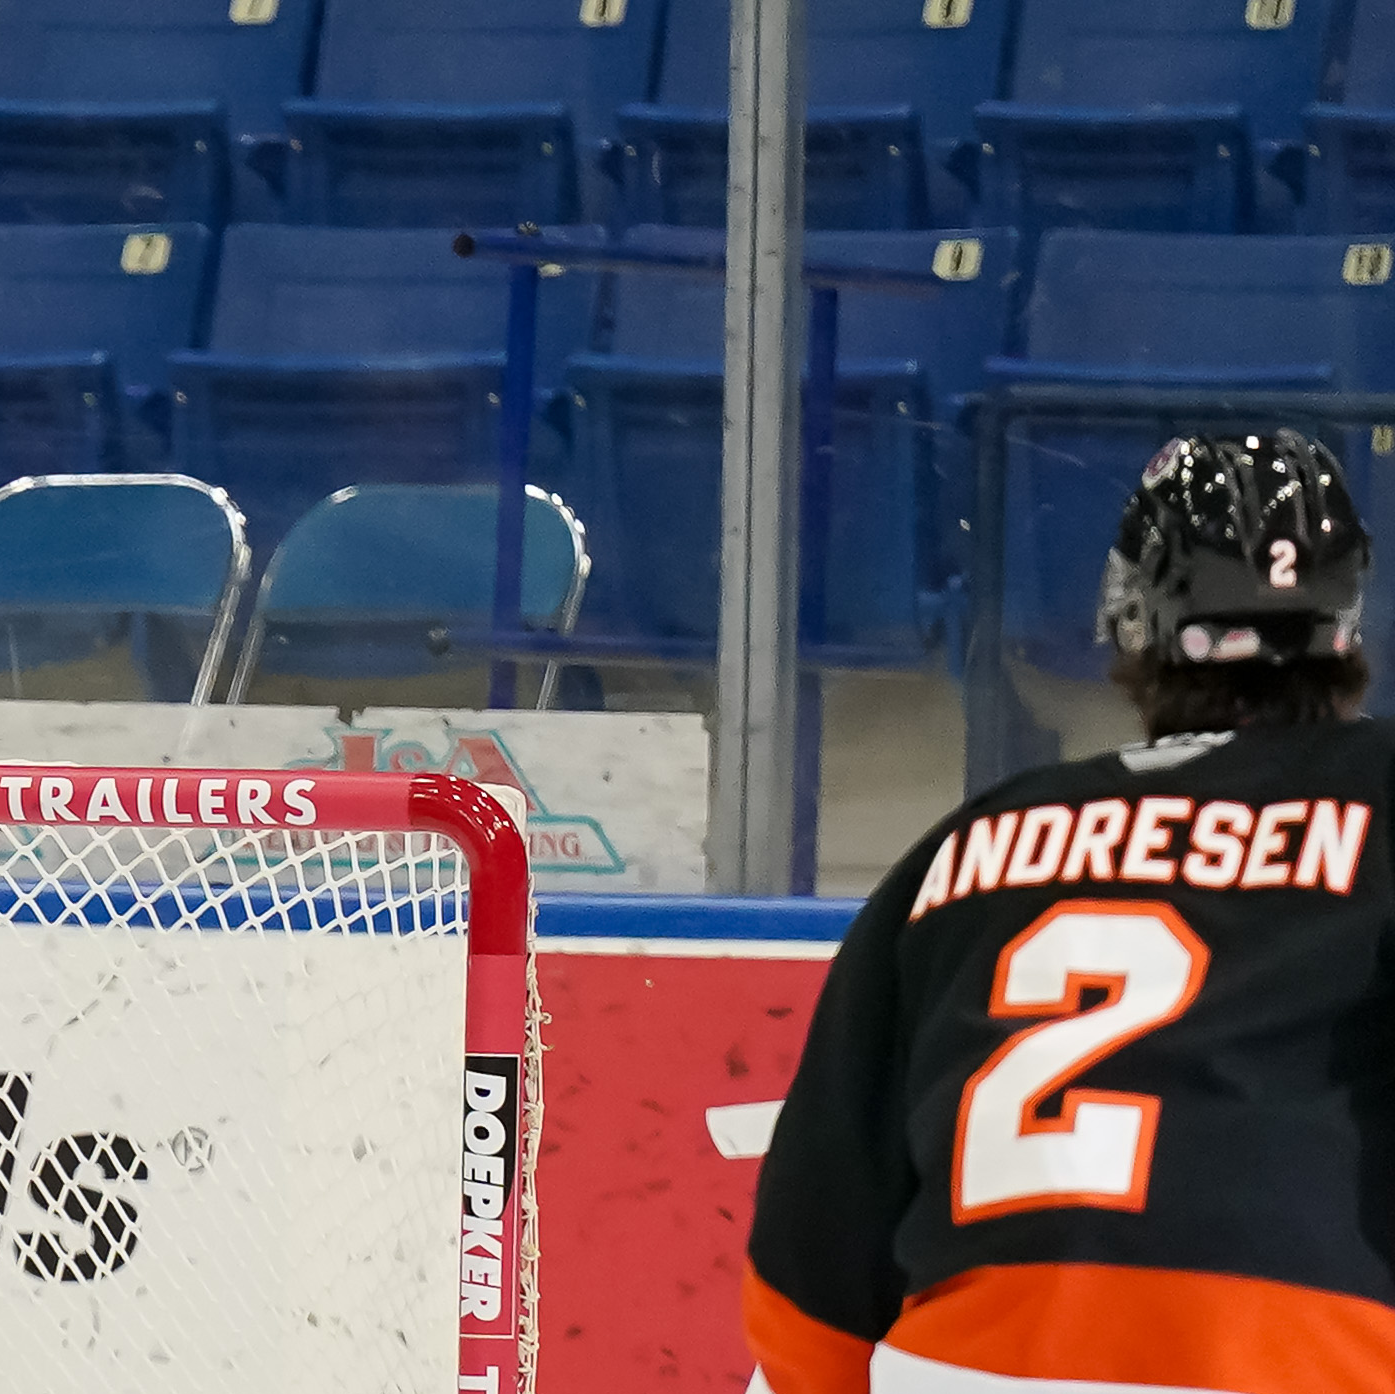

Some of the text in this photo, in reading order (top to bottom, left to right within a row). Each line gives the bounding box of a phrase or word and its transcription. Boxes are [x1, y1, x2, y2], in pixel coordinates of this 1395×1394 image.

[1267, 538, 1299, 588] 2
[908, 797, 1371, 924] ANDRESEN
[951, 898, 1211, 1226] 2
[458, 1069, 508, 1323] DOEPKER
